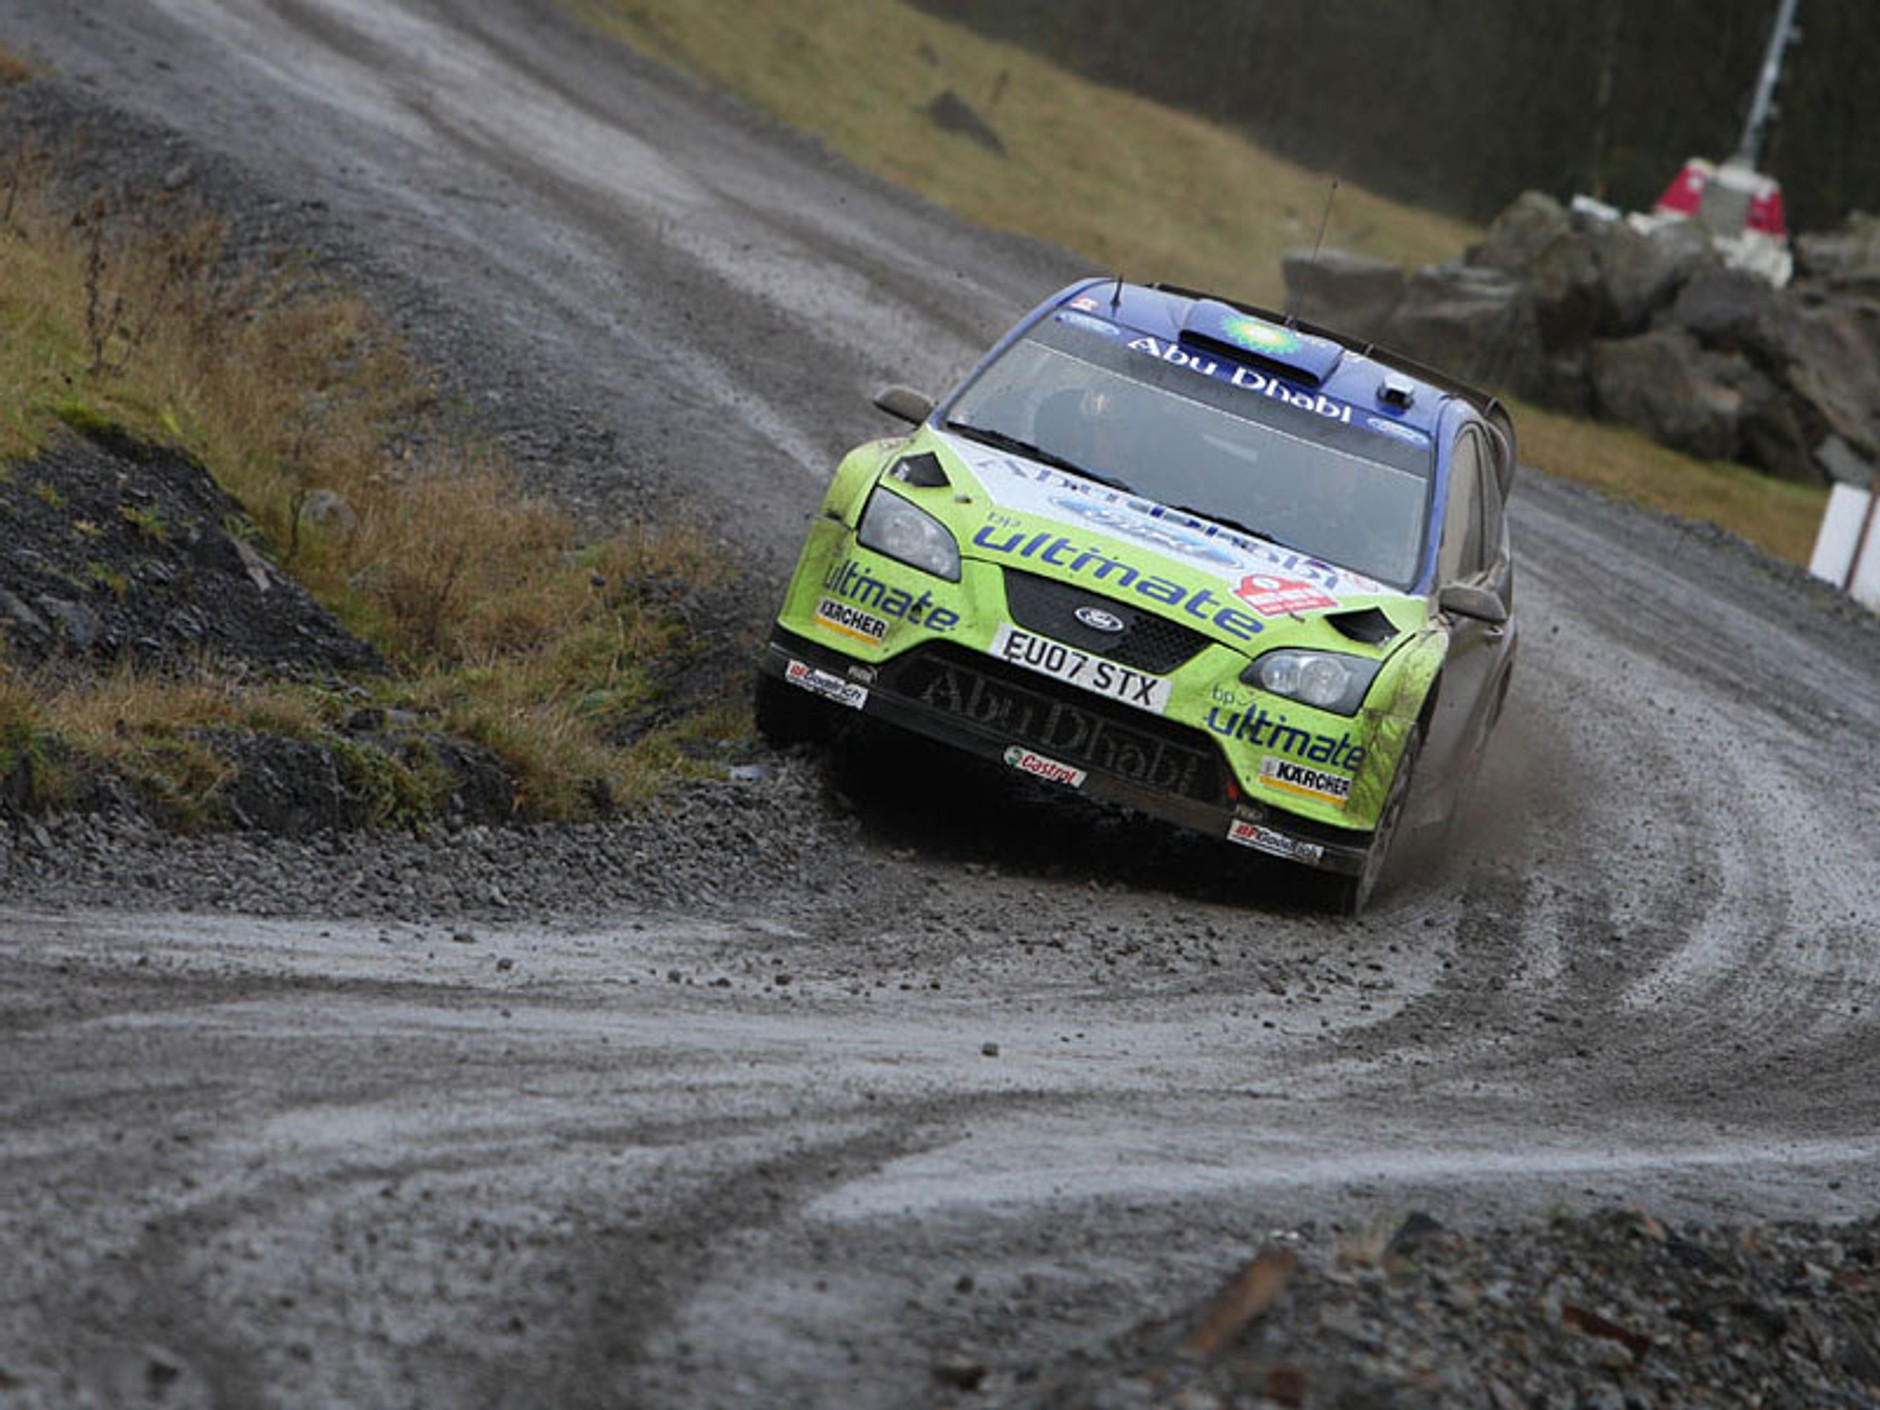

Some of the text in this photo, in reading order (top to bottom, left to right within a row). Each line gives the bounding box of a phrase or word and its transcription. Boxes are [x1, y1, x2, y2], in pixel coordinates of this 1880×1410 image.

[1127, 336, 1351, 423] Abu Dhabi
[824, 557, 961, 633] ultimate
[971, 525, 1265, 641] ultimate
[1003, 629, 1158, 706] EU07 STX
[920, 666, 1199, 794] Abu Dhabi
[1206, 703, 1366, 772] ultimate
[1022, 754, 1077, 784] Castrol
